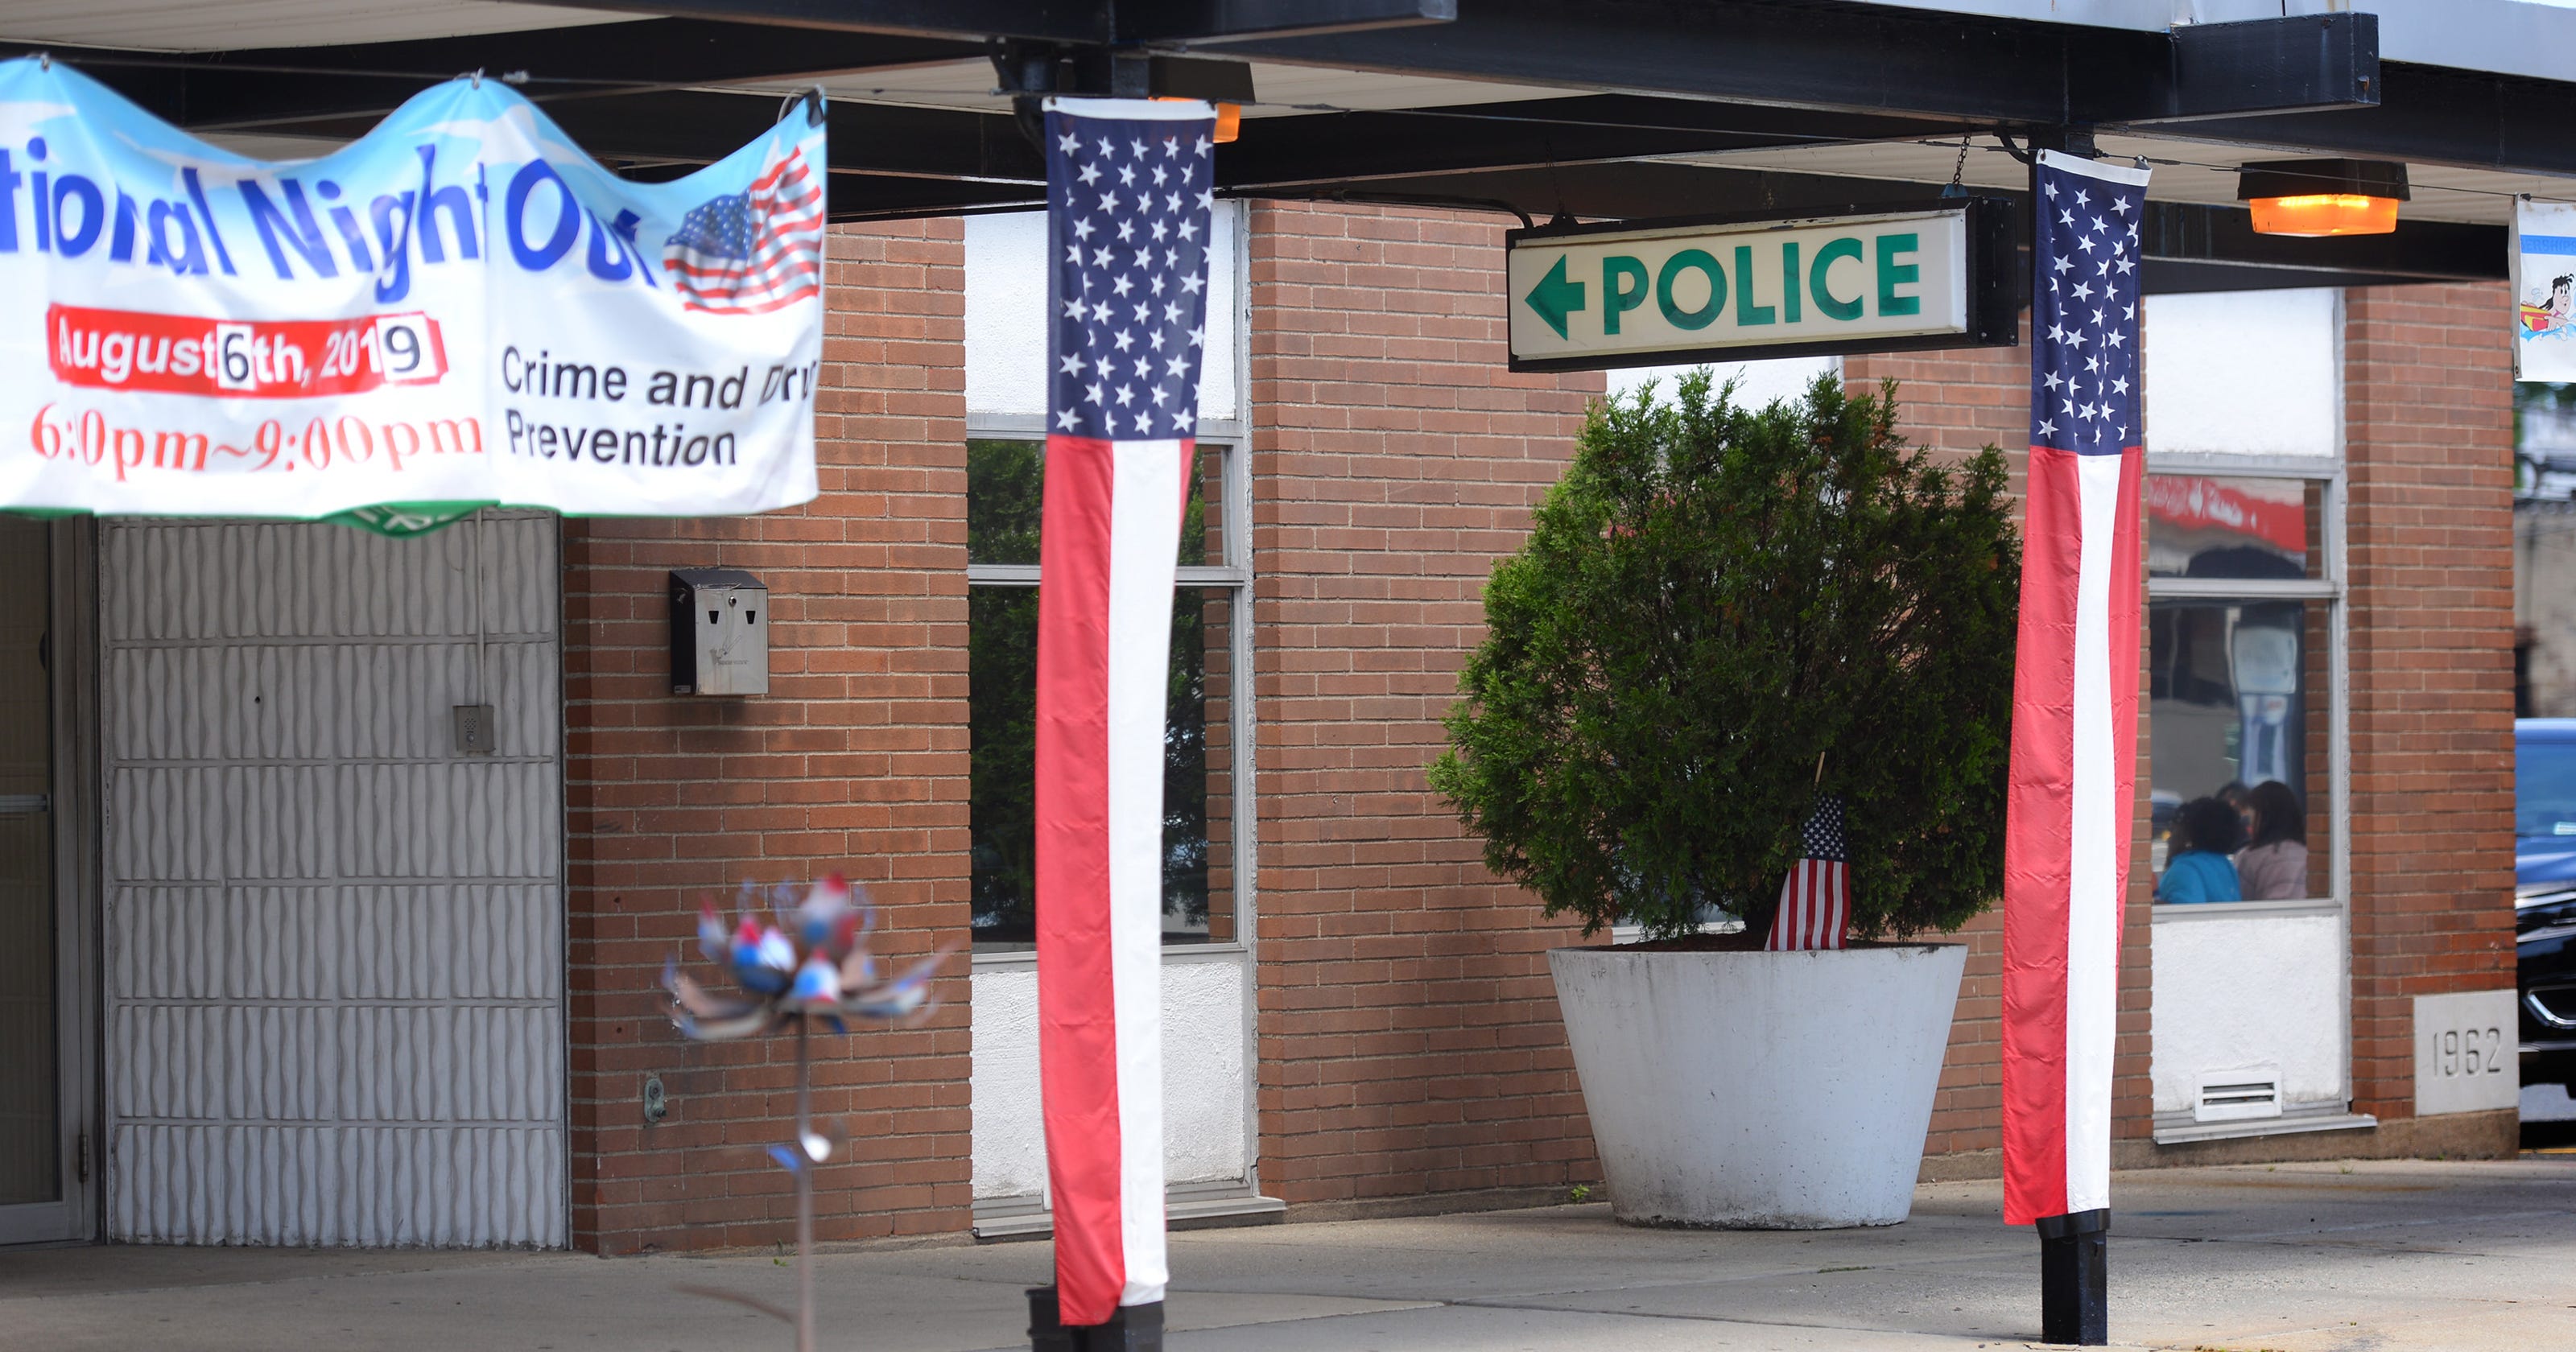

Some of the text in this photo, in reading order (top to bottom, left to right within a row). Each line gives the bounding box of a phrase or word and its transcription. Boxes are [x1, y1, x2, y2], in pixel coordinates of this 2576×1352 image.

[237, 142, 489, 304] Night
[1602, 232, 1921, 336] POLICE
[320, 325, 420, 376] 2019
[502, 345, 628, 402] Crime
[646, 365, 748, 409] and
[506, 408, 738, 468] Prevention
[2433, 1027, 2501, 1077] 1962
